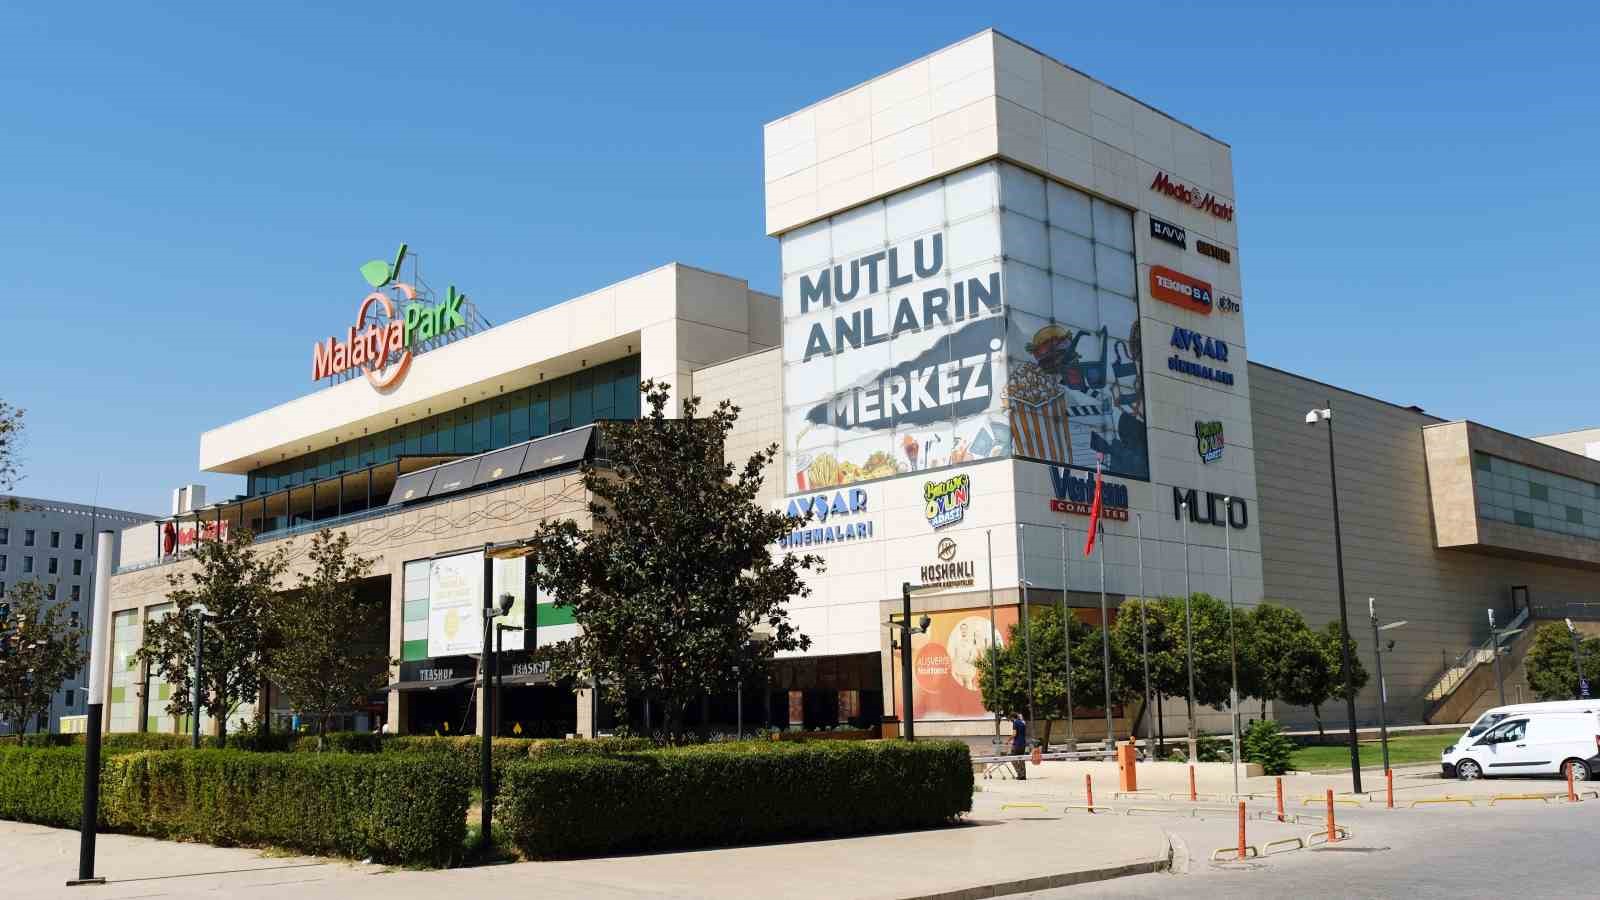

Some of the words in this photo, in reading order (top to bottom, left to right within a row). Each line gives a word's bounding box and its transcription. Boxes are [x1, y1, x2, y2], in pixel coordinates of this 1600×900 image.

[800, 232, 943, 314] MUTLU
[803, 272, 1001, 363] ANLARIN
[827, 338, 1004, 427] MERKEZİ
